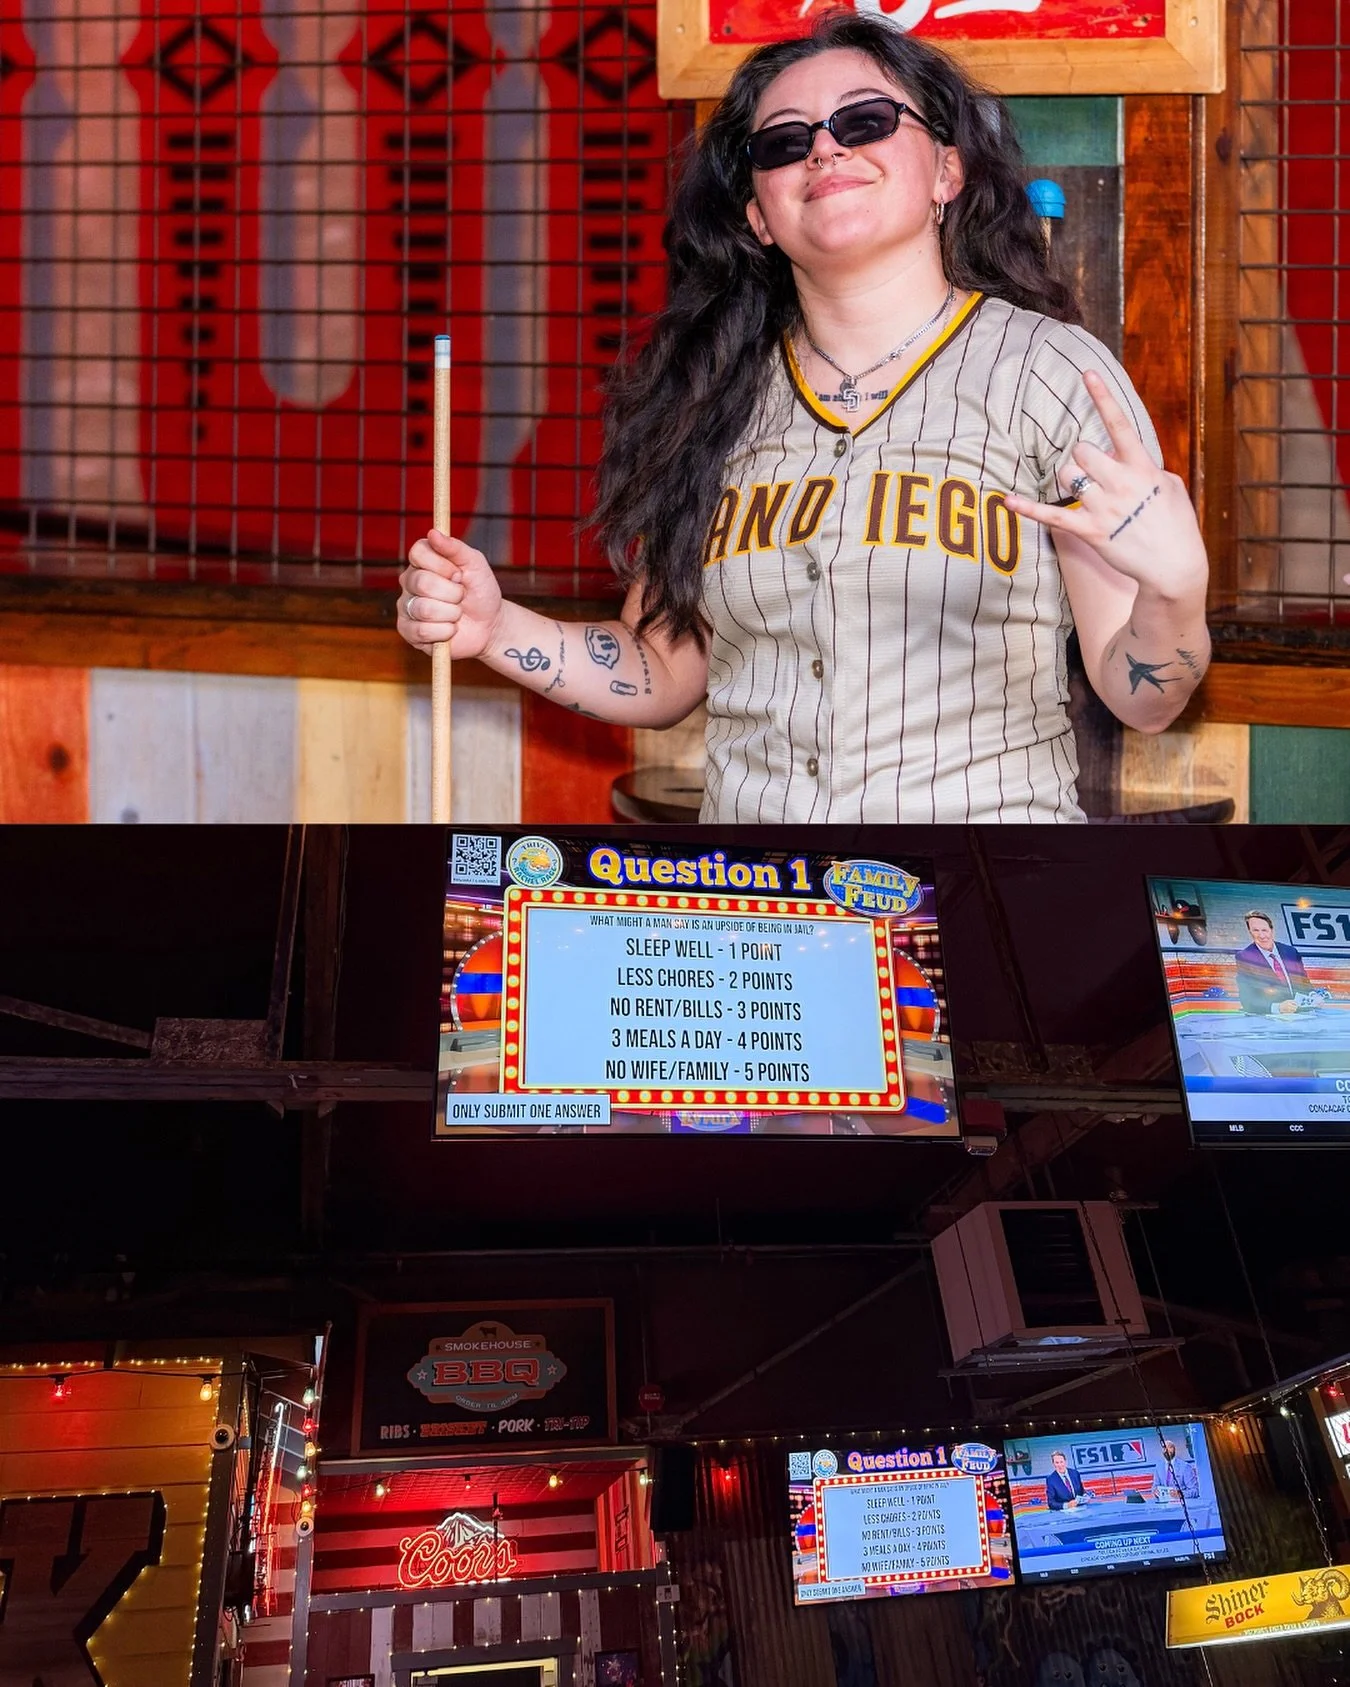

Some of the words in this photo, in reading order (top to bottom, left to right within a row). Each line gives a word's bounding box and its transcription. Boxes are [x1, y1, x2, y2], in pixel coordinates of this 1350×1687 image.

[703, 480, 795, 568] AN
[589, 847, 781, 889] Question
[790, 858, 811, 891] 1
[590, 915, 614, 926] WHAT
[617, 916, 643, 928] MIGHT
[645, 917, 651, 928] A
[653, 918, 672, 929] MAN
[674, 919, 690, 929] SAY
[692, 919, 700, 930] IS
[702, 920, 713, 930] AN
[715, 920, 744, 932] UPSIDE
[746, 921, 756, 932] OF
[758, 922, 782, 933] BEING
[783, 923, 792, 934] IN
[794, 924, 815, 935] JAIL?
[626, 938, 671, 957] SLEEP
[675, 939, 714, 959] WELL
[729, 942, 736, 960] 1
[741, 942, 782, 961] POINT
[617, 967, 653, 986] LESS
[658, 968, 714, 988] CHORES
[729, 971, 738, 989] 2
[742, 971, 793, 991] POINTS
[610, 997, 631, 1017] NO
[636, 998, 723, 1019] RENT/BILLS
[737, 1001, 746, 1020] 3
[751, 1001, 802, 1021] POINTS
[611, 1028, 621, 1048] 3
[626, 1029, 676, 1049] MEALS
[681, 1030, 690, 1049] A
[695, 1030, 722, 1049] DAY
[737, 1031, 747, 1050] 4
[751, 1031, 802, 1051] POINTS
[605, 1060, 626, 1080] NO
[630, 1060, 729, 1081] WIFE/FAMILY
[744, 1062, 753, 1081] 5
[758, 1062, 810, 1082] POINTS
[452, 1103, 481, 1119] ONLY
[484, 1103, 527, 1119] SUBMIT
[530, 1103, 552, 1119] ONE
[554, 1103, 601, 1119] ANSWER
[444, 1340, 532, 1352] SMOKEHOUSE
[433, 1358, 540, 1386] BBQ
[380, 1424, 410, 1440] RIBS
[498, 1417, 535, 1434] PORK
[847, 1447, 933, 1472] Question
[935, 1446, 947, 1466] 1
[1076, 1446, 1110, 1465] FS1
[398, 1531, 517, 1588] Coors
[1205, 1580, 1269, 1625] Shiner
[1224, 1603, 1265, 1629] BOCK
